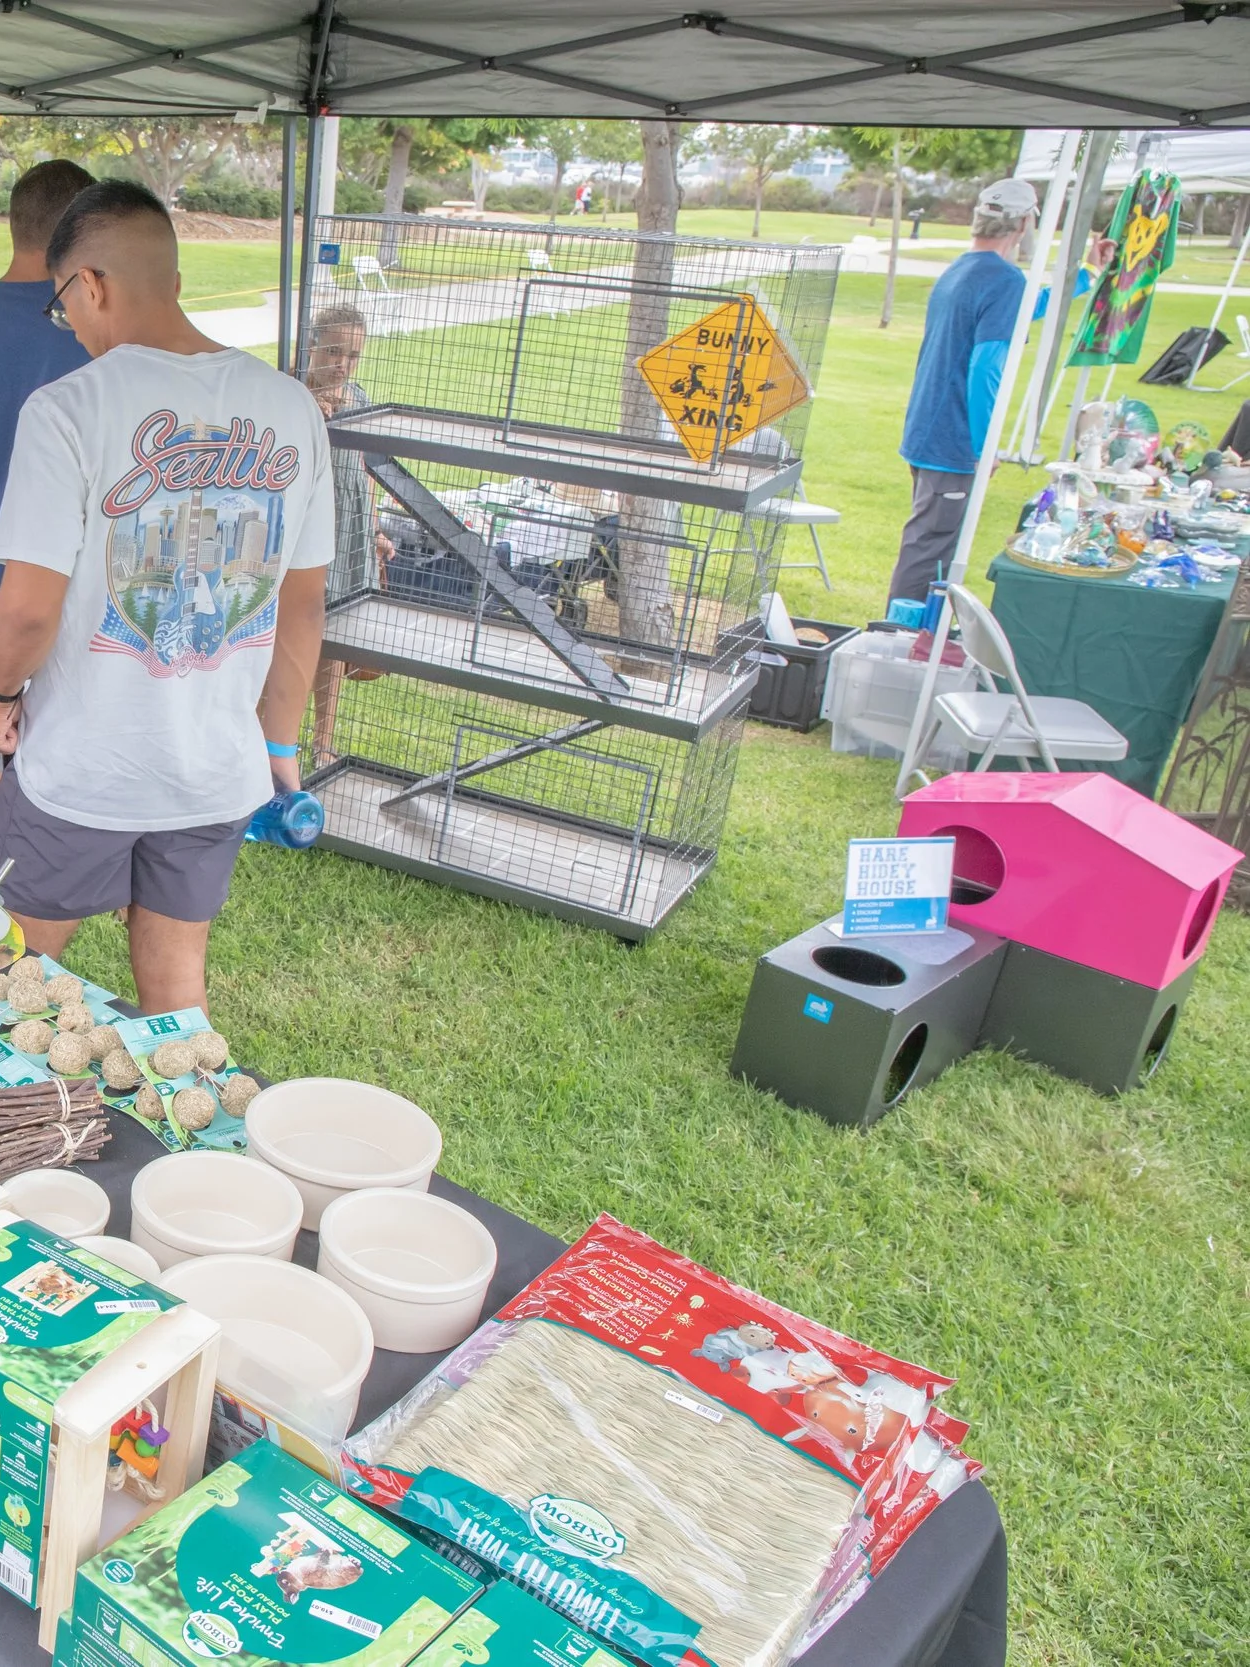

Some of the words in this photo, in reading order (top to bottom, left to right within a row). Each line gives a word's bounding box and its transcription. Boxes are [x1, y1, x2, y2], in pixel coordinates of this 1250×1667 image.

[697, 329, 770, 355] BUNNY
[679, 405, 743, 432] XING
[101, 408, 300, 519] Seattle
[859, 847, 909, 862] HARE
[858, 863, 917, 879] HIDEY
[857, 880, 916, 896] HOUSE
[586, 1267, 634, 1300] Enriching
[605, 1272, 633, 1291] mental
[612, 1268, 641, 1289] activity
[655, 1267, 677, 1282] hand
[675, 1277, 688, 1288] by
[0, 1294, 13, 1305] JEU
[12, 1301, 22, 1310] DE
[631, 1287, 667, 1311] Promotes
[639, 1284, 672, 1307] physical
[15, 1311, 38, 1328] PLAY
[21, 1306, 43, 1321] TABLE
[620, 1309, 647, 1329] 100%
[628, 1307, 653, 1324] Made
[643, 1301, 663, 1315] Fun
[497, 1520, 521, 1541] pets
[534, 1496, 619, 1553] OXBOW
[445, 1511, 511, 1566] MAT
[527, 1537, 570, 1571] lifestyle
[228, 1570, 247, 1586] JEU
[563, 1559, 604, 1592] healthy
[190, 1572, 224, 1603] Life
[220, 1576, 254, 1604] POST
[243, 1582, 259, 1595] DE
[503, 1547, 626, 1634] TIMOTHY
[255, 1590, 291, 1619] POTEAU
[603, 1584, 646, 1617] Creating
[217, 1592, 290, 1651] Enriched
[250, 1599, 283, 1626] PLAY
[190, 1612, 239, 1651] OXBOW
